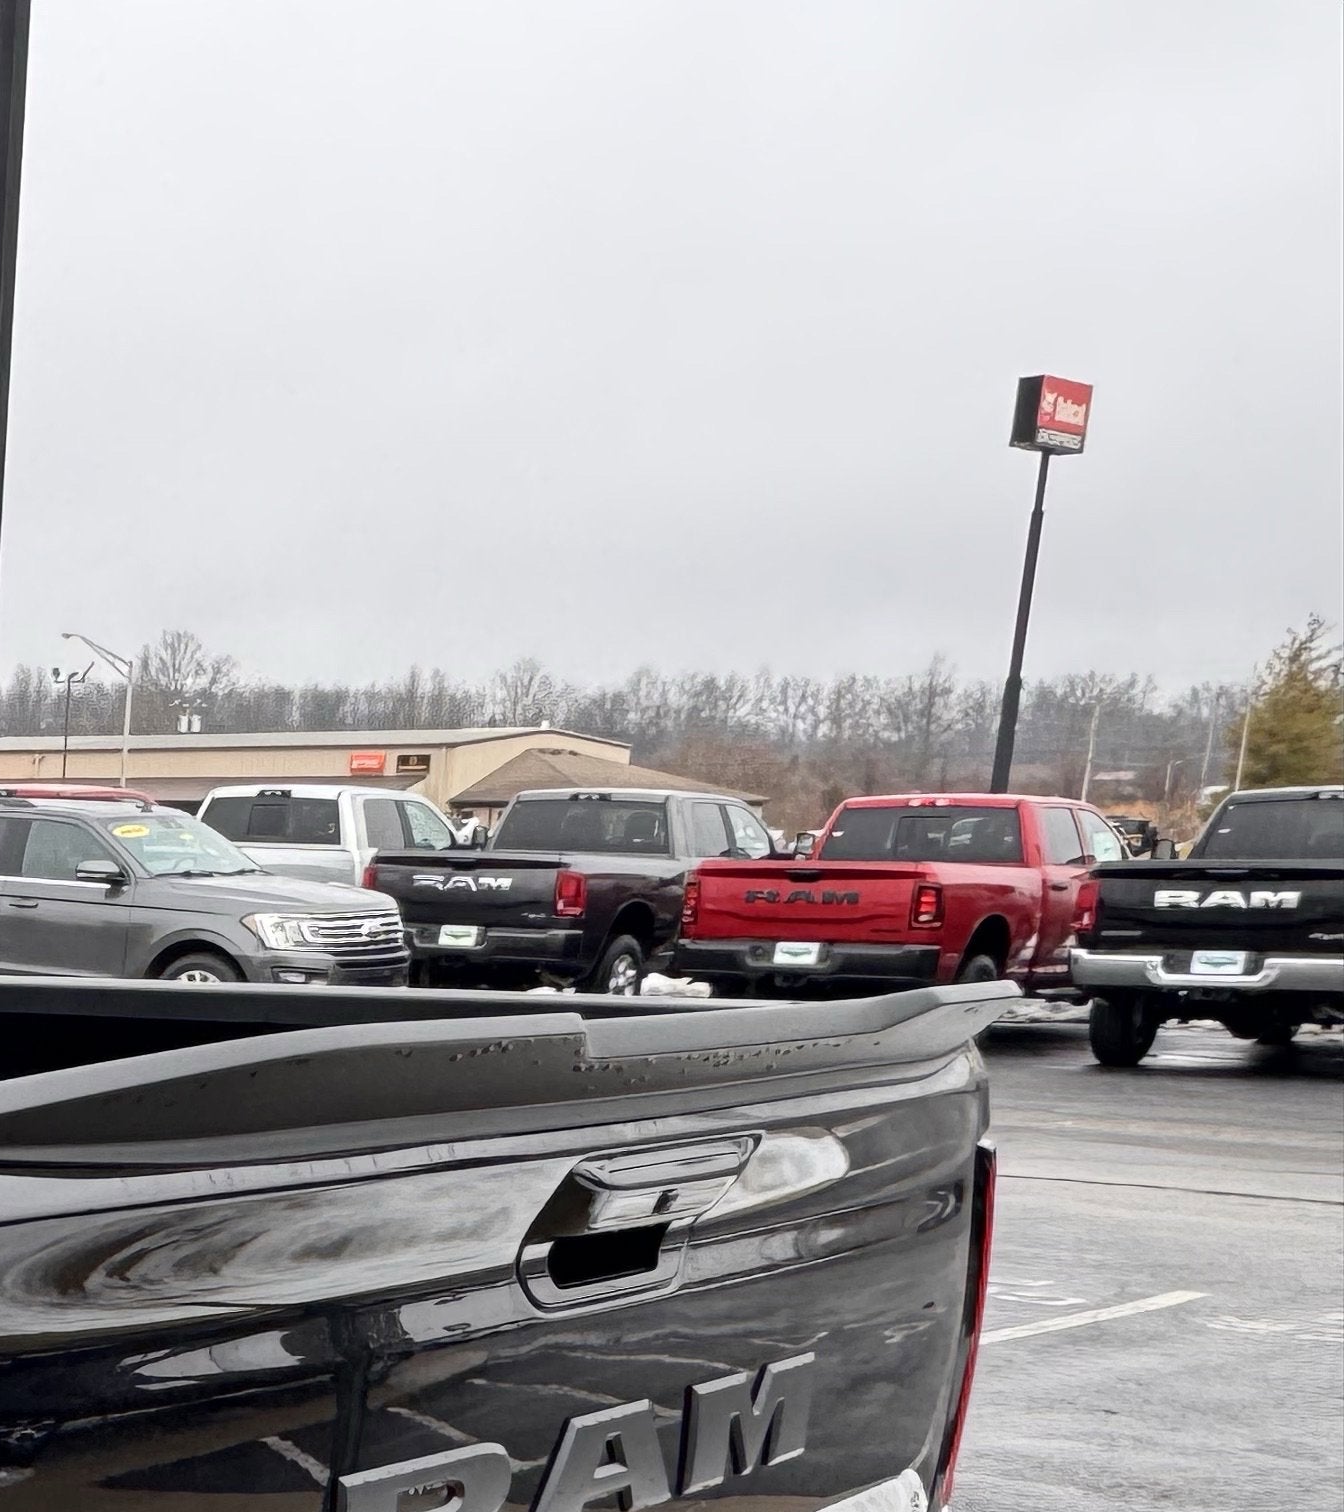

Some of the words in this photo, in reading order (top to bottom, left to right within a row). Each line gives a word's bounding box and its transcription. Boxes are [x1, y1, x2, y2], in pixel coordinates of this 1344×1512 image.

[412, 874, 513, 891] RAM
[745, 889, 860, 905] RAM
[1153, 890, 1302, 909] RAM
